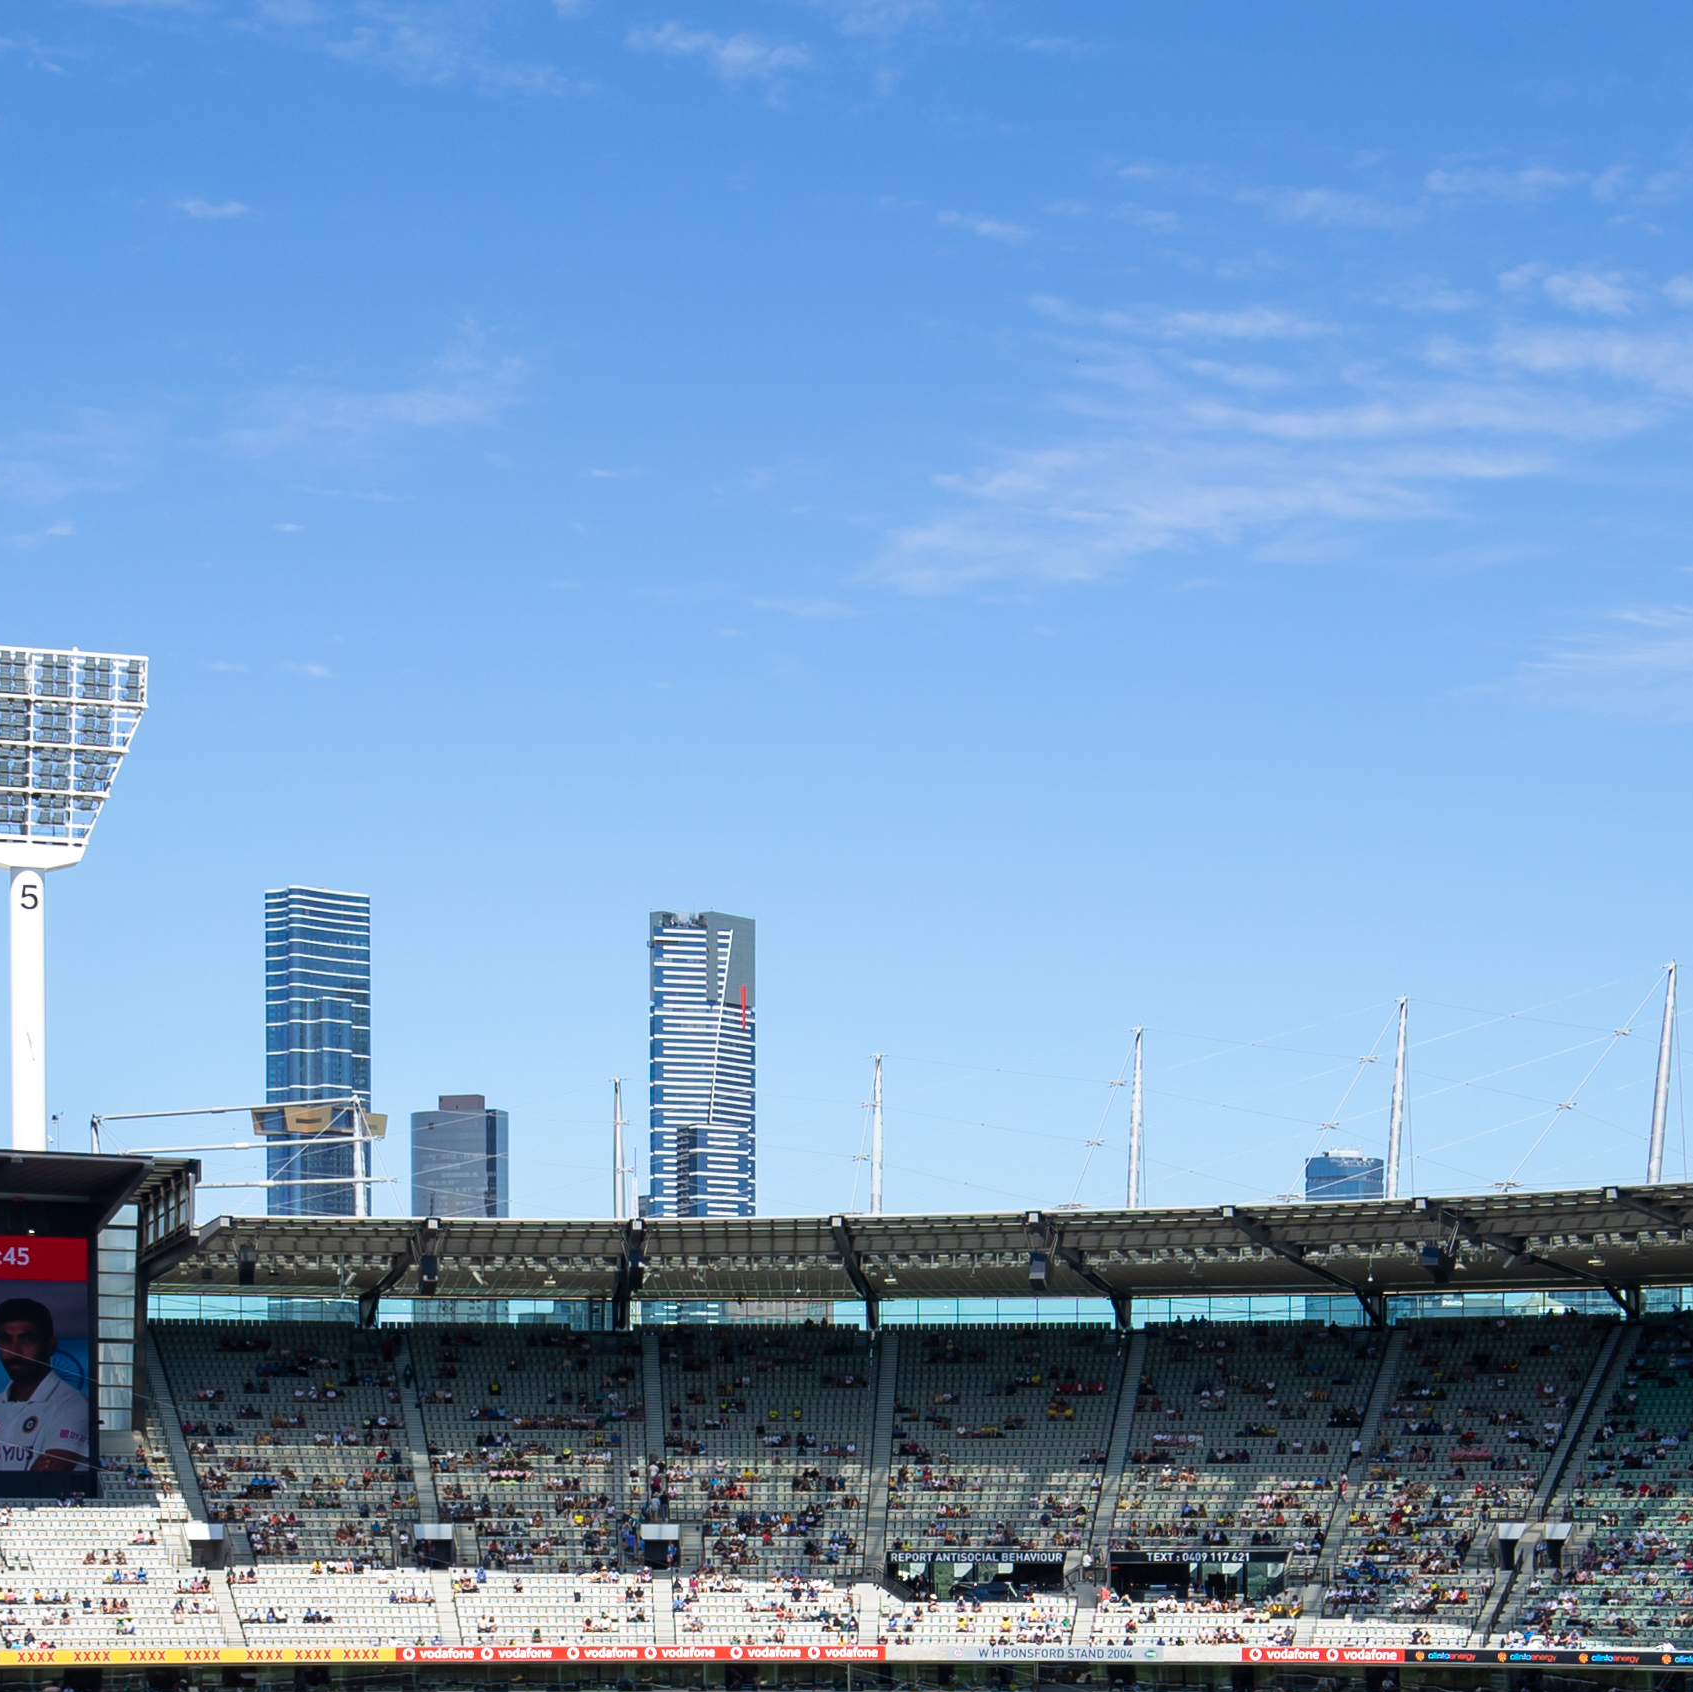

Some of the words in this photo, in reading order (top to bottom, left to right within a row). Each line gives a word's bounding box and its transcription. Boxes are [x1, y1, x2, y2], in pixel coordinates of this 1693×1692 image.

[21, 885, 38, 909] 5
[18, 1653, 54, 1662] XXXX
[420, 1650, 474, 1659] vodafone
[662, 1649, 715, 1658] vodafone
[978, 1648, 990, 1658] W
[992, 1648, 999, 1658] H
[1003, 1648, 1064, 1658] PONSFORD
[1068, 1648, 1104, 1658] STAND
[1108, 1648, 1132, 1658] 2004
[1267, 1650, 1319, 1659] vodafone
